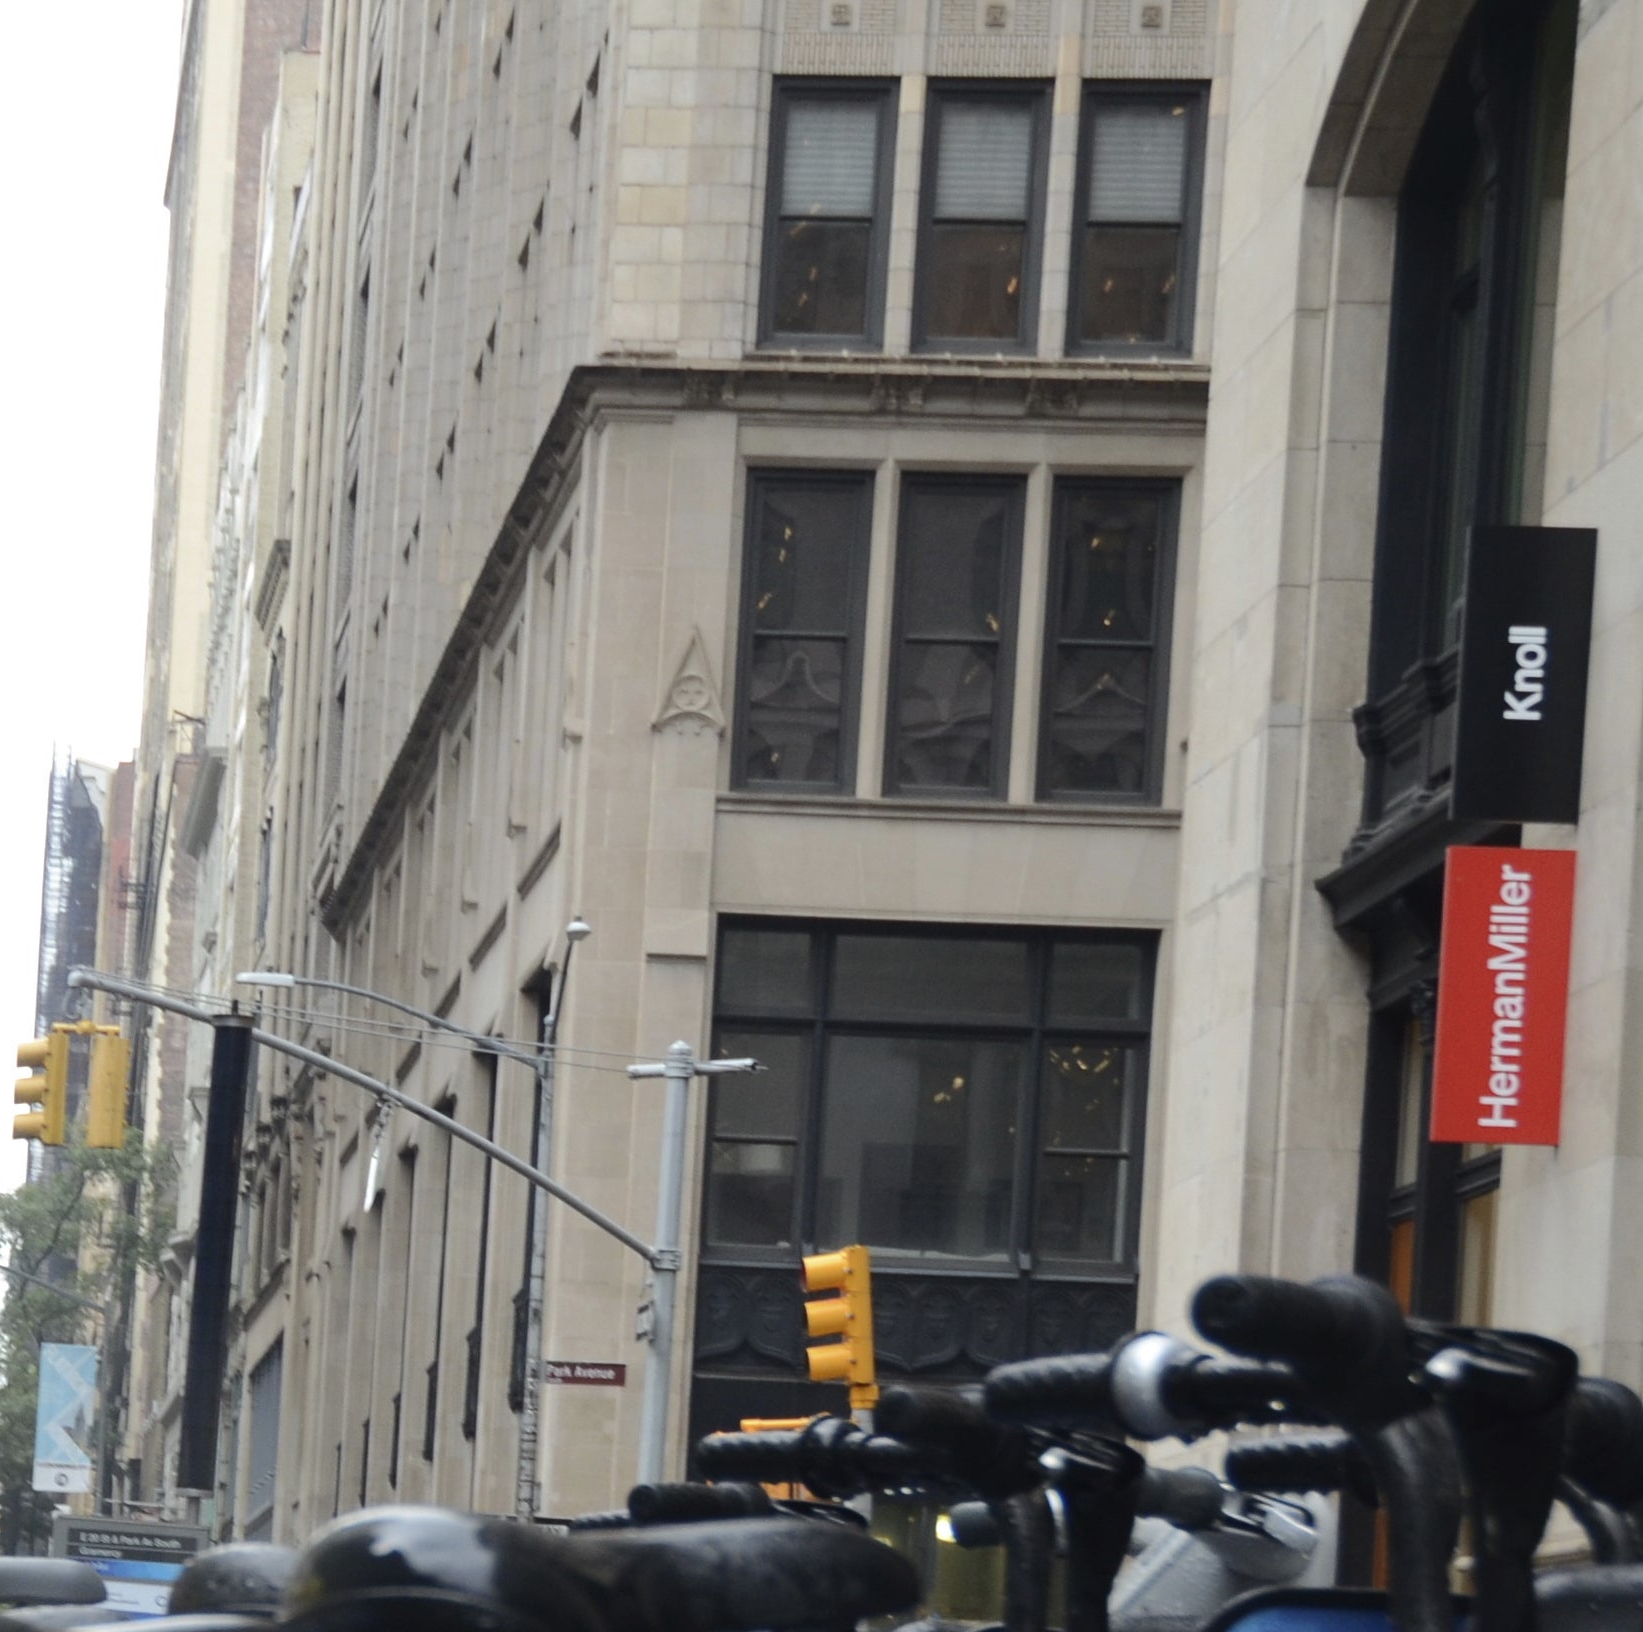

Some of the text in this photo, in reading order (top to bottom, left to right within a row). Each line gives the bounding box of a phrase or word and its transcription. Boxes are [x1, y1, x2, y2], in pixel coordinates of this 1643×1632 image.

[1503, 625, 1549, 721] Knoll
[1478, 864, 1533, 1129] HermanMiller
[545, 1364, 616, 1379] Park Avenue
[119, 1535, 141, 1546] Park
[154, 1538, 182, 1549] South
